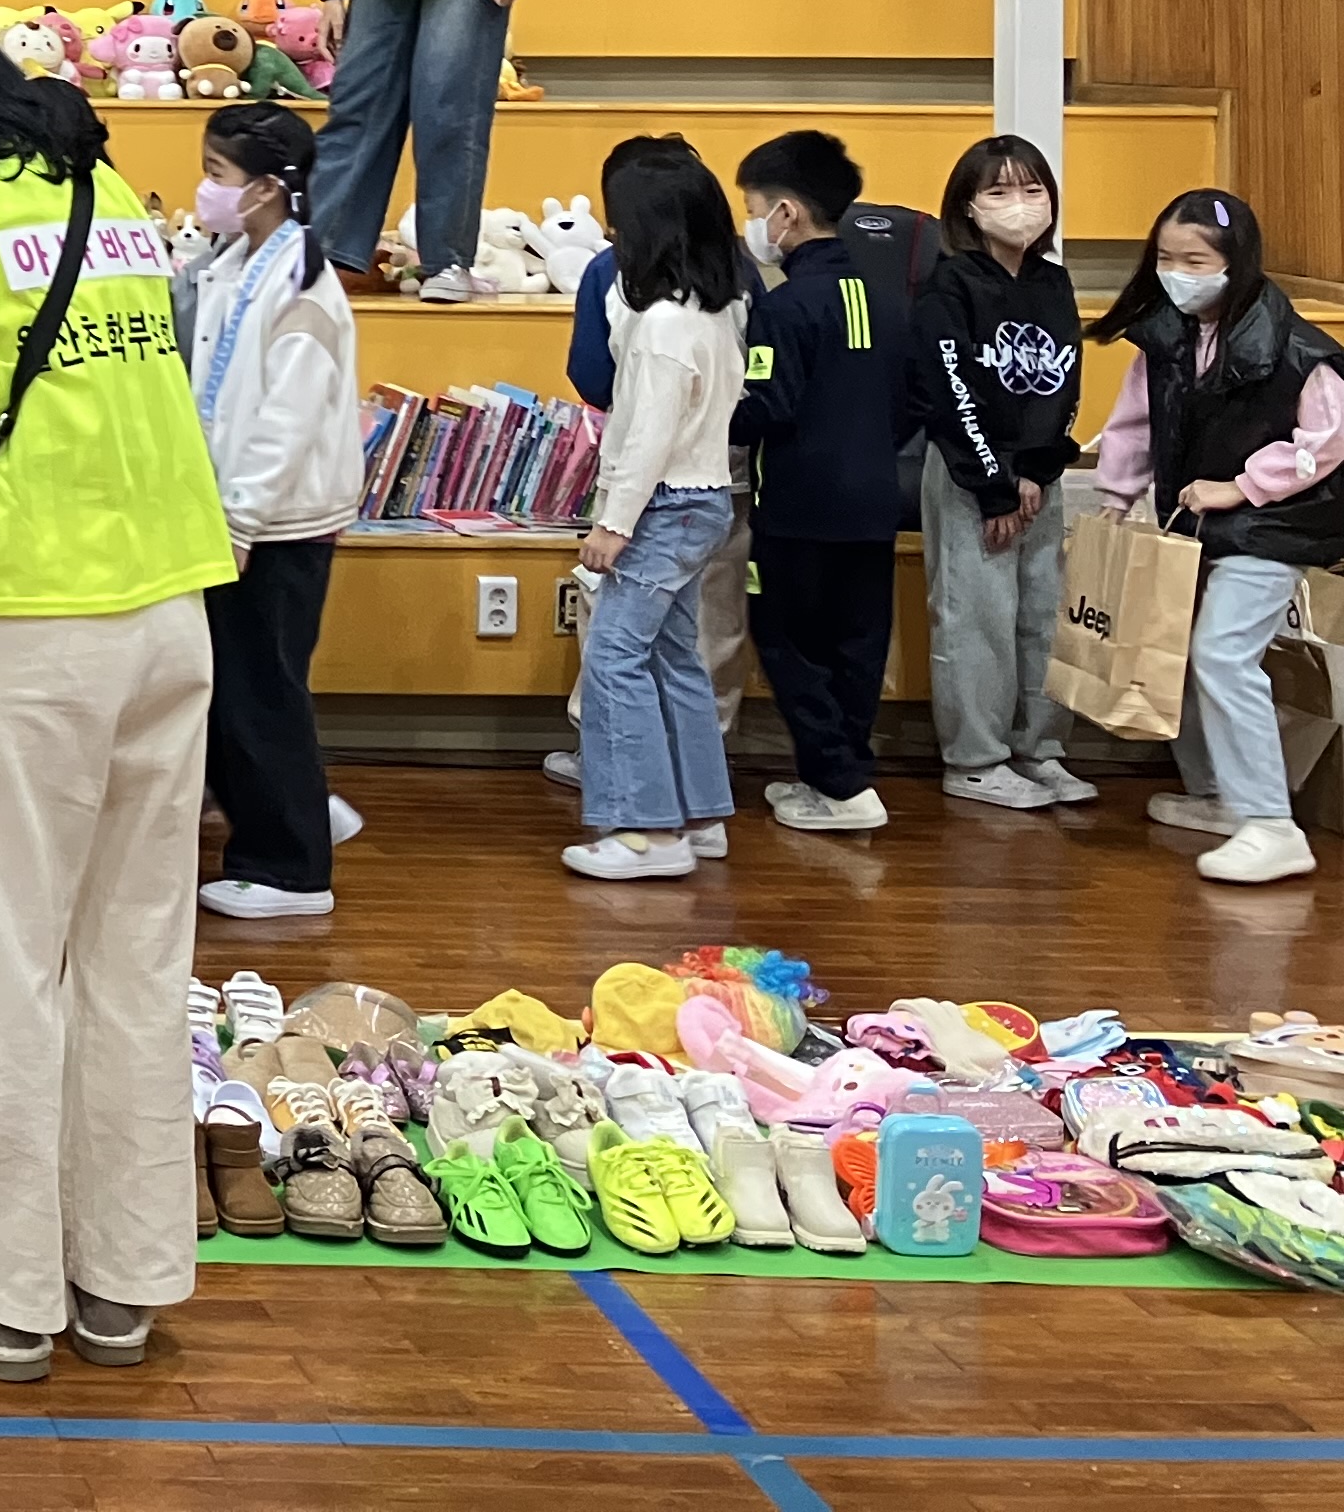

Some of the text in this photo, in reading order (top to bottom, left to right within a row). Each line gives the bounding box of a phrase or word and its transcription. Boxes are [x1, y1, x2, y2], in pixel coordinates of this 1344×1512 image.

[12, 226, 161, 276] 아바다
[939, 339, 1000, 478] DEMON HUNTER
